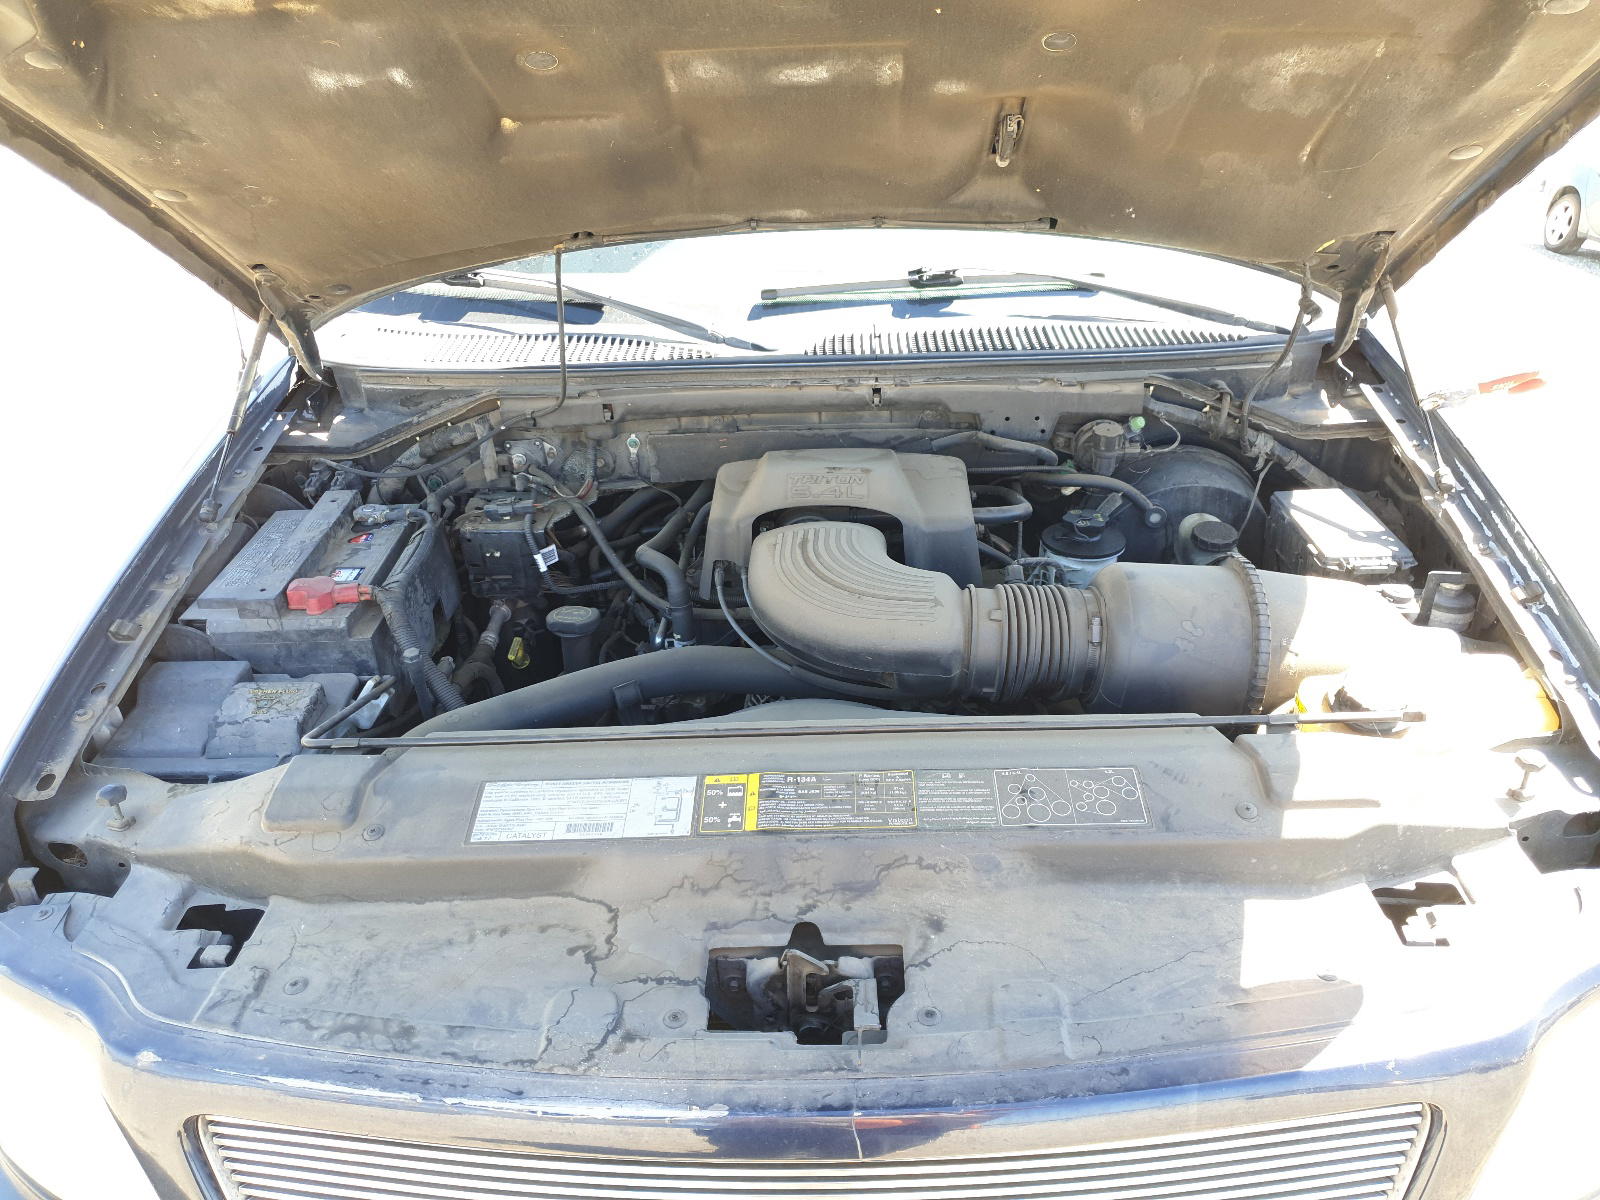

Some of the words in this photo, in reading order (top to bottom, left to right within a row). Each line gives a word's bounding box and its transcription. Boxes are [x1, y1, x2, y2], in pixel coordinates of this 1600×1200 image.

[789, 474, 865, 485] TRITON
[790, 486, 865, 499] 5.4L
[506, 832, 547, 840] CATALYST
